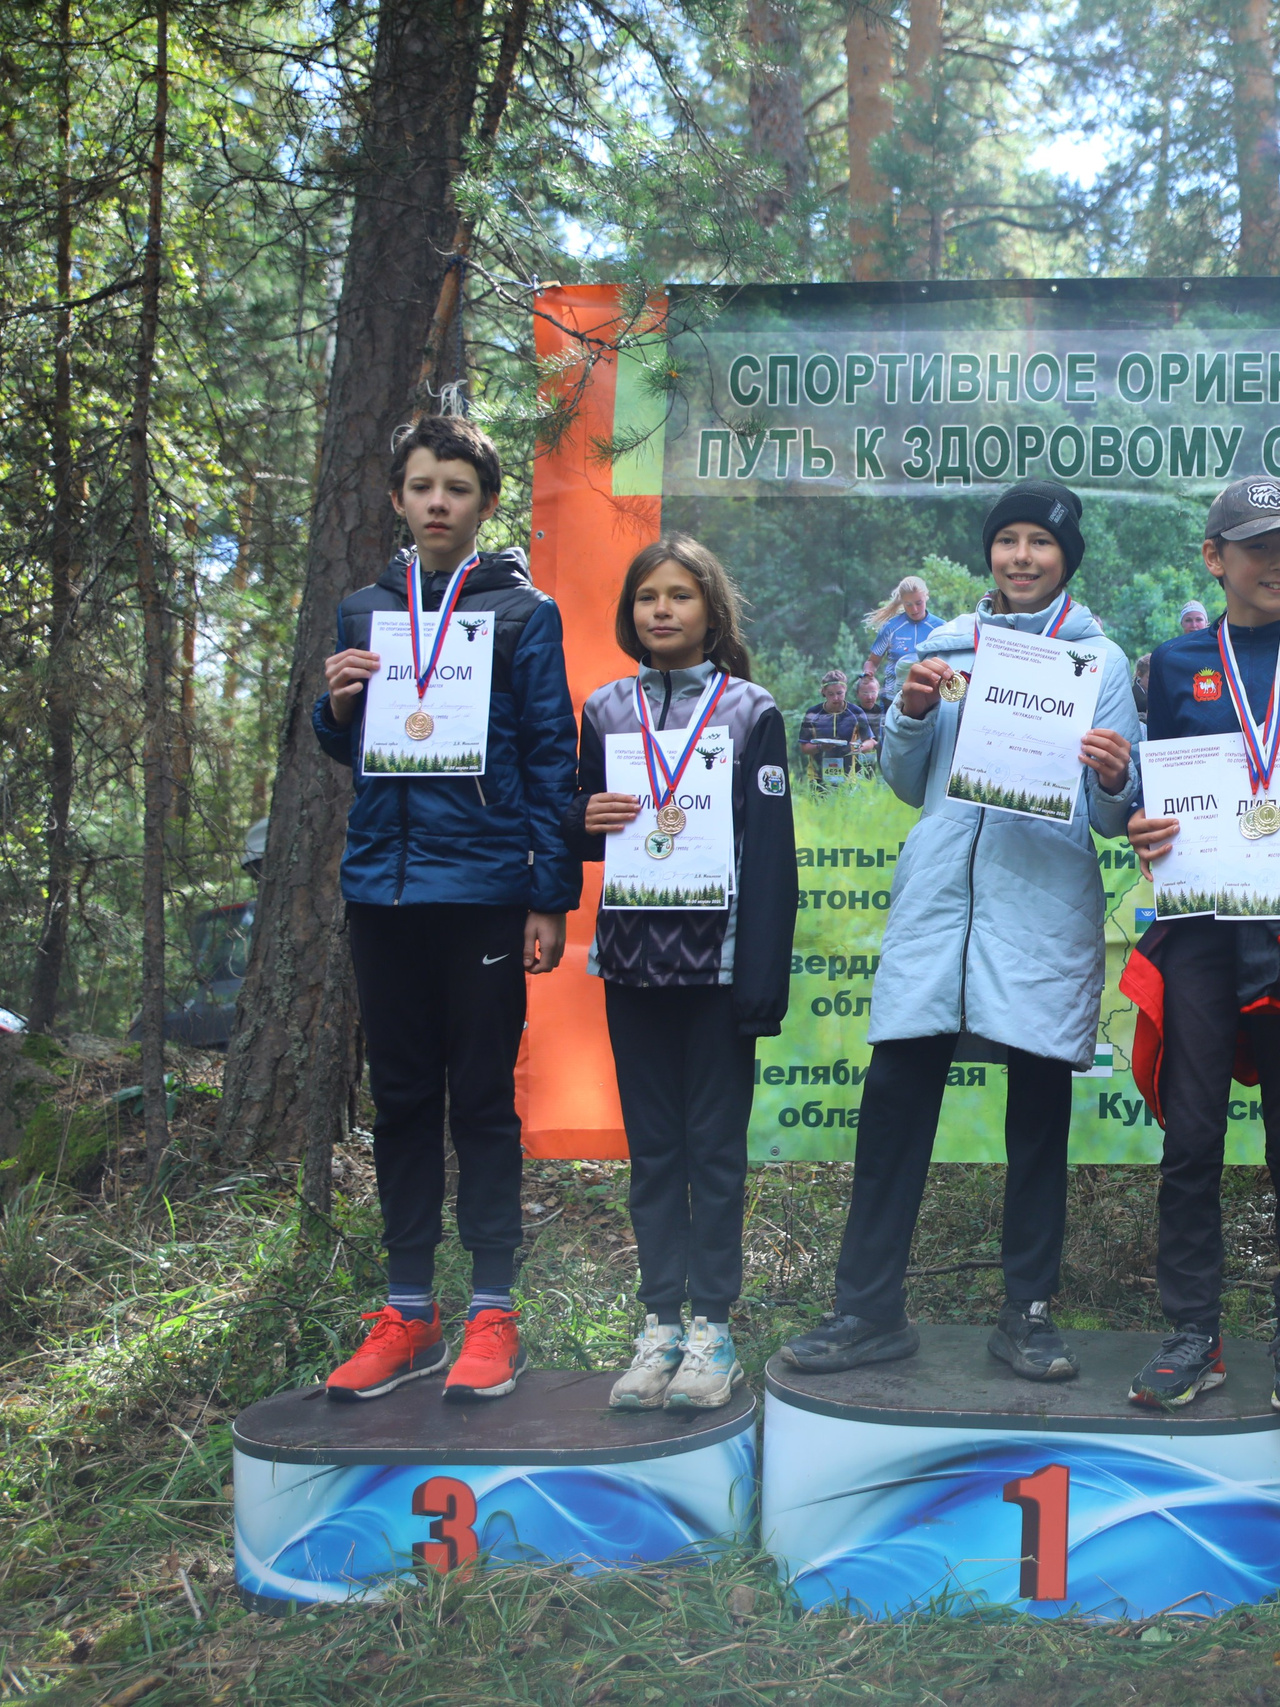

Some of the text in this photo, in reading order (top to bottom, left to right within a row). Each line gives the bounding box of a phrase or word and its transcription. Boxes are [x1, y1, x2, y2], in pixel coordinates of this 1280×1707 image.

[729, 351, 1097, 408] СПОРТИВНОЕ
[697, 427, 836, 479] ПУТЬ
[855, 426, 886, 479] К
[902, 424, 1244, 488] ЗДОРОВОМУ
[985, 686, 1075, 717] ДИПЛОМ
[1012, 711, 1042, 720] НАГРАЖДАЕТСЯ
[1163, 794, 1218, 815] ДИПЛ
[797, 843, 900, 868] анты-
[797, 889, 891, 910] втоно
[790, 954, 880, 981] верд
[811, 990, 871, 1018] обл
[778, 1101, 860, 1129] обла
[412, 1475, 479, 1587] 3
[1003, 1463, 1070, 1600] 1
